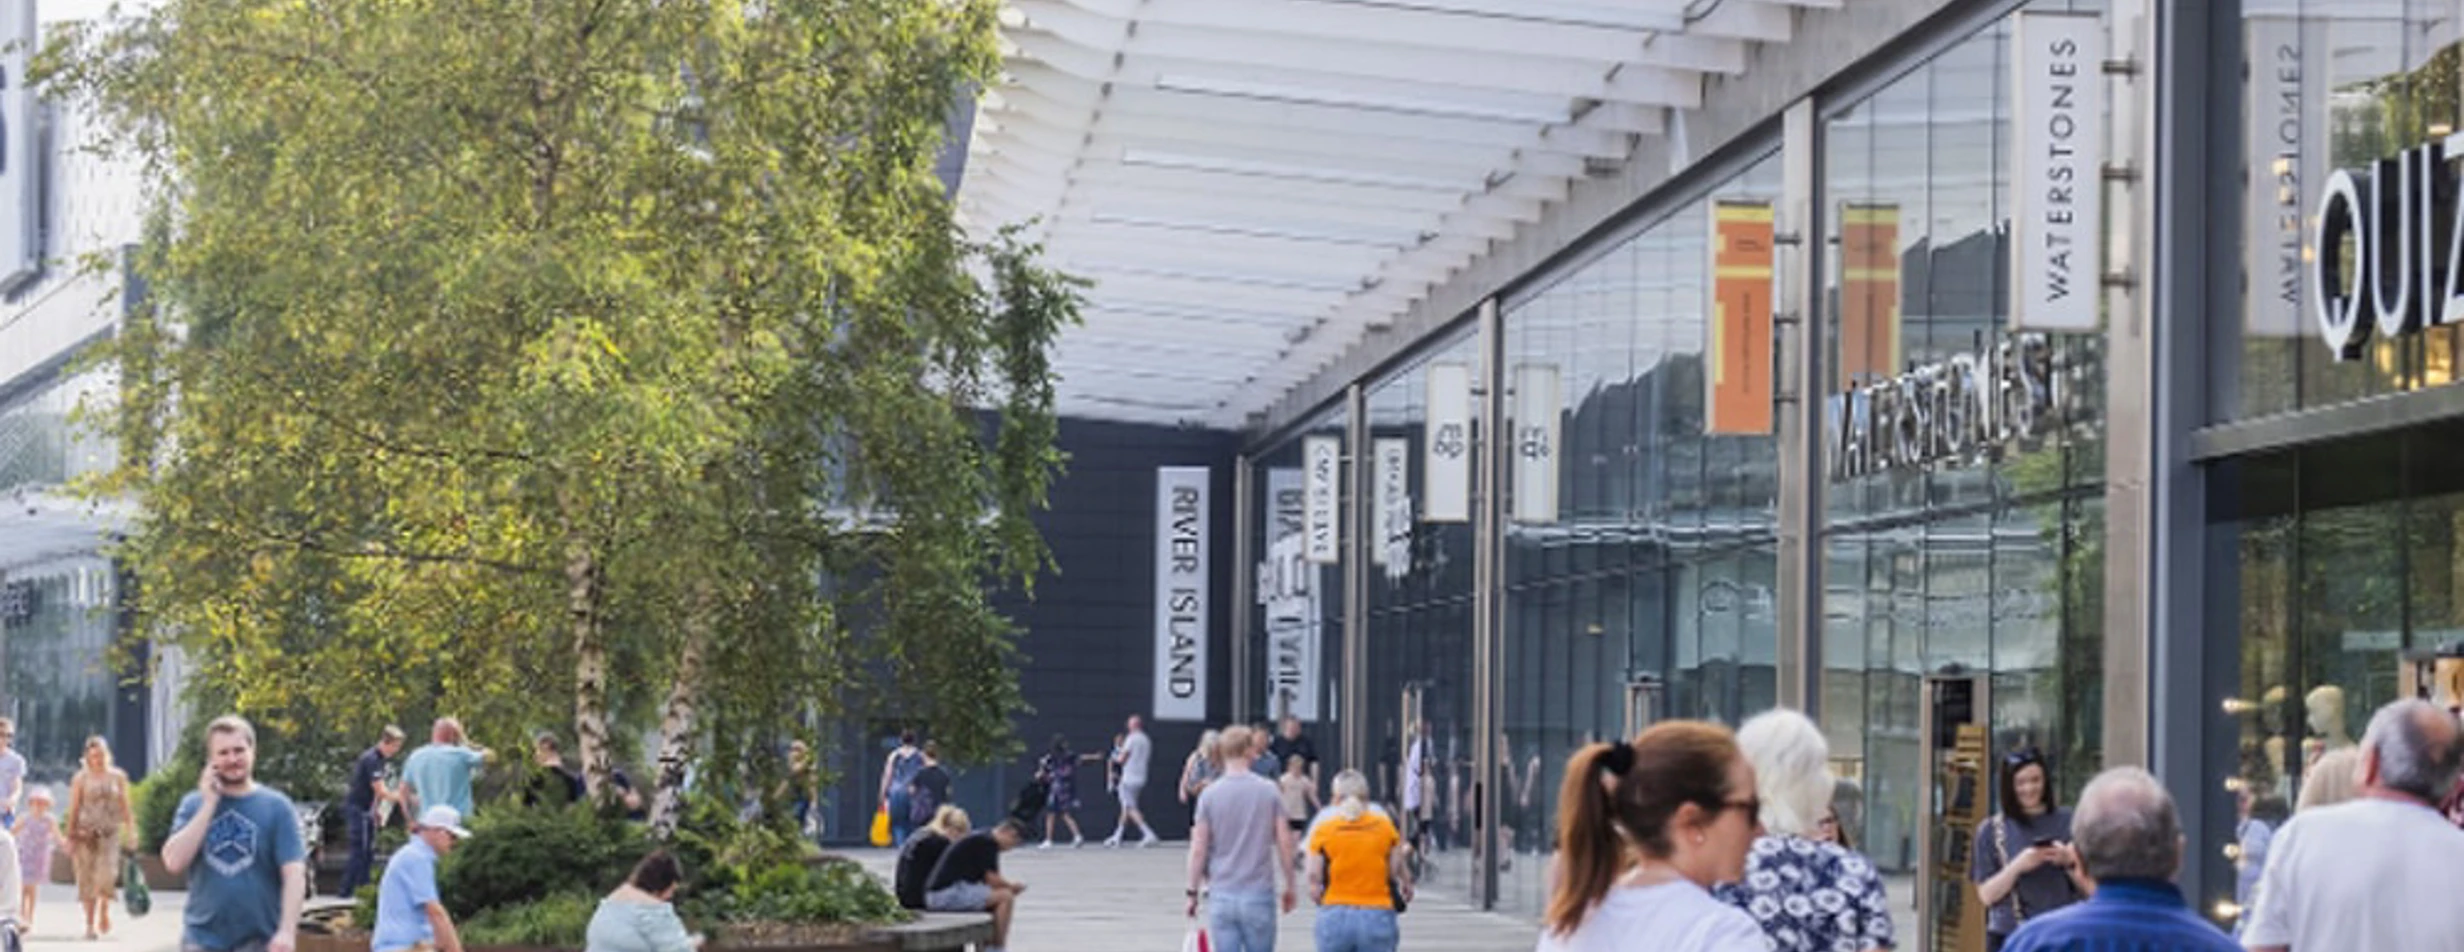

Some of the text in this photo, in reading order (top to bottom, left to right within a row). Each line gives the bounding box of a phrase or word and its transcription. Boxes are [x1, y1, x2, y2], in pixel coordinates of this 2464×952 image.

[2046, 38, 2077, 303] WATERSTONES
[1168, 485, 1199, 699] RIVER ISLAND
